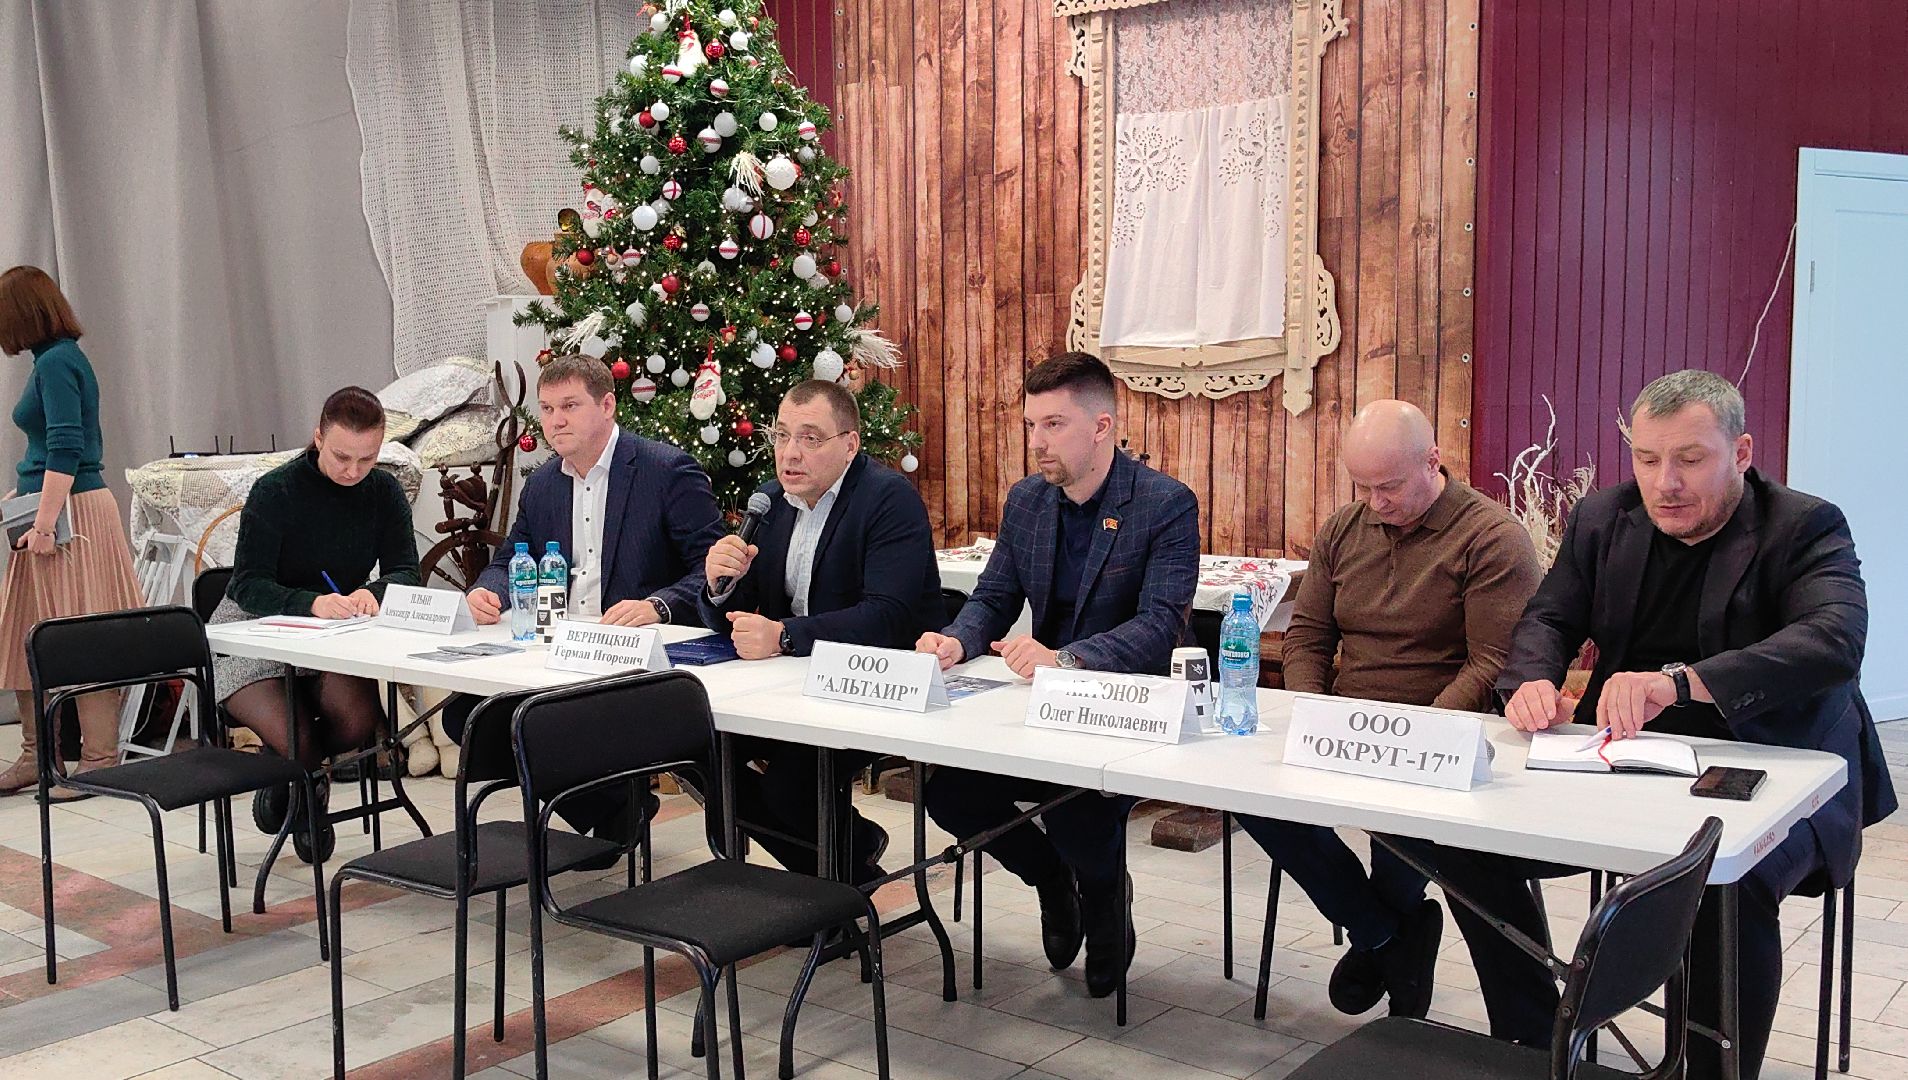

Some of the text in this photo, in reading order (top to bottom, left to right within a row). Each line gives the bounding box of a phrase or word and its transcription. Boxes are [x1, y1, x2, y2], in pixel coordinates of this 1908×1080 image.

[566, 629, 641, 649] ВЕРНИЦКИЙ
[554, 645, 644, 666] Герман Игоревич
[847, 654, 889, 674] ООО
[817, 674, 919, 701] "АЛЬТАИР"
[1066, 679, 1150, 704] ОНОВ
[1039, 702, 1168, 735] Олег Николаевич
[1348, 711, 1411, 737] ООО
[1303, 734, 1460, 773] "ОКРУГ-17"
